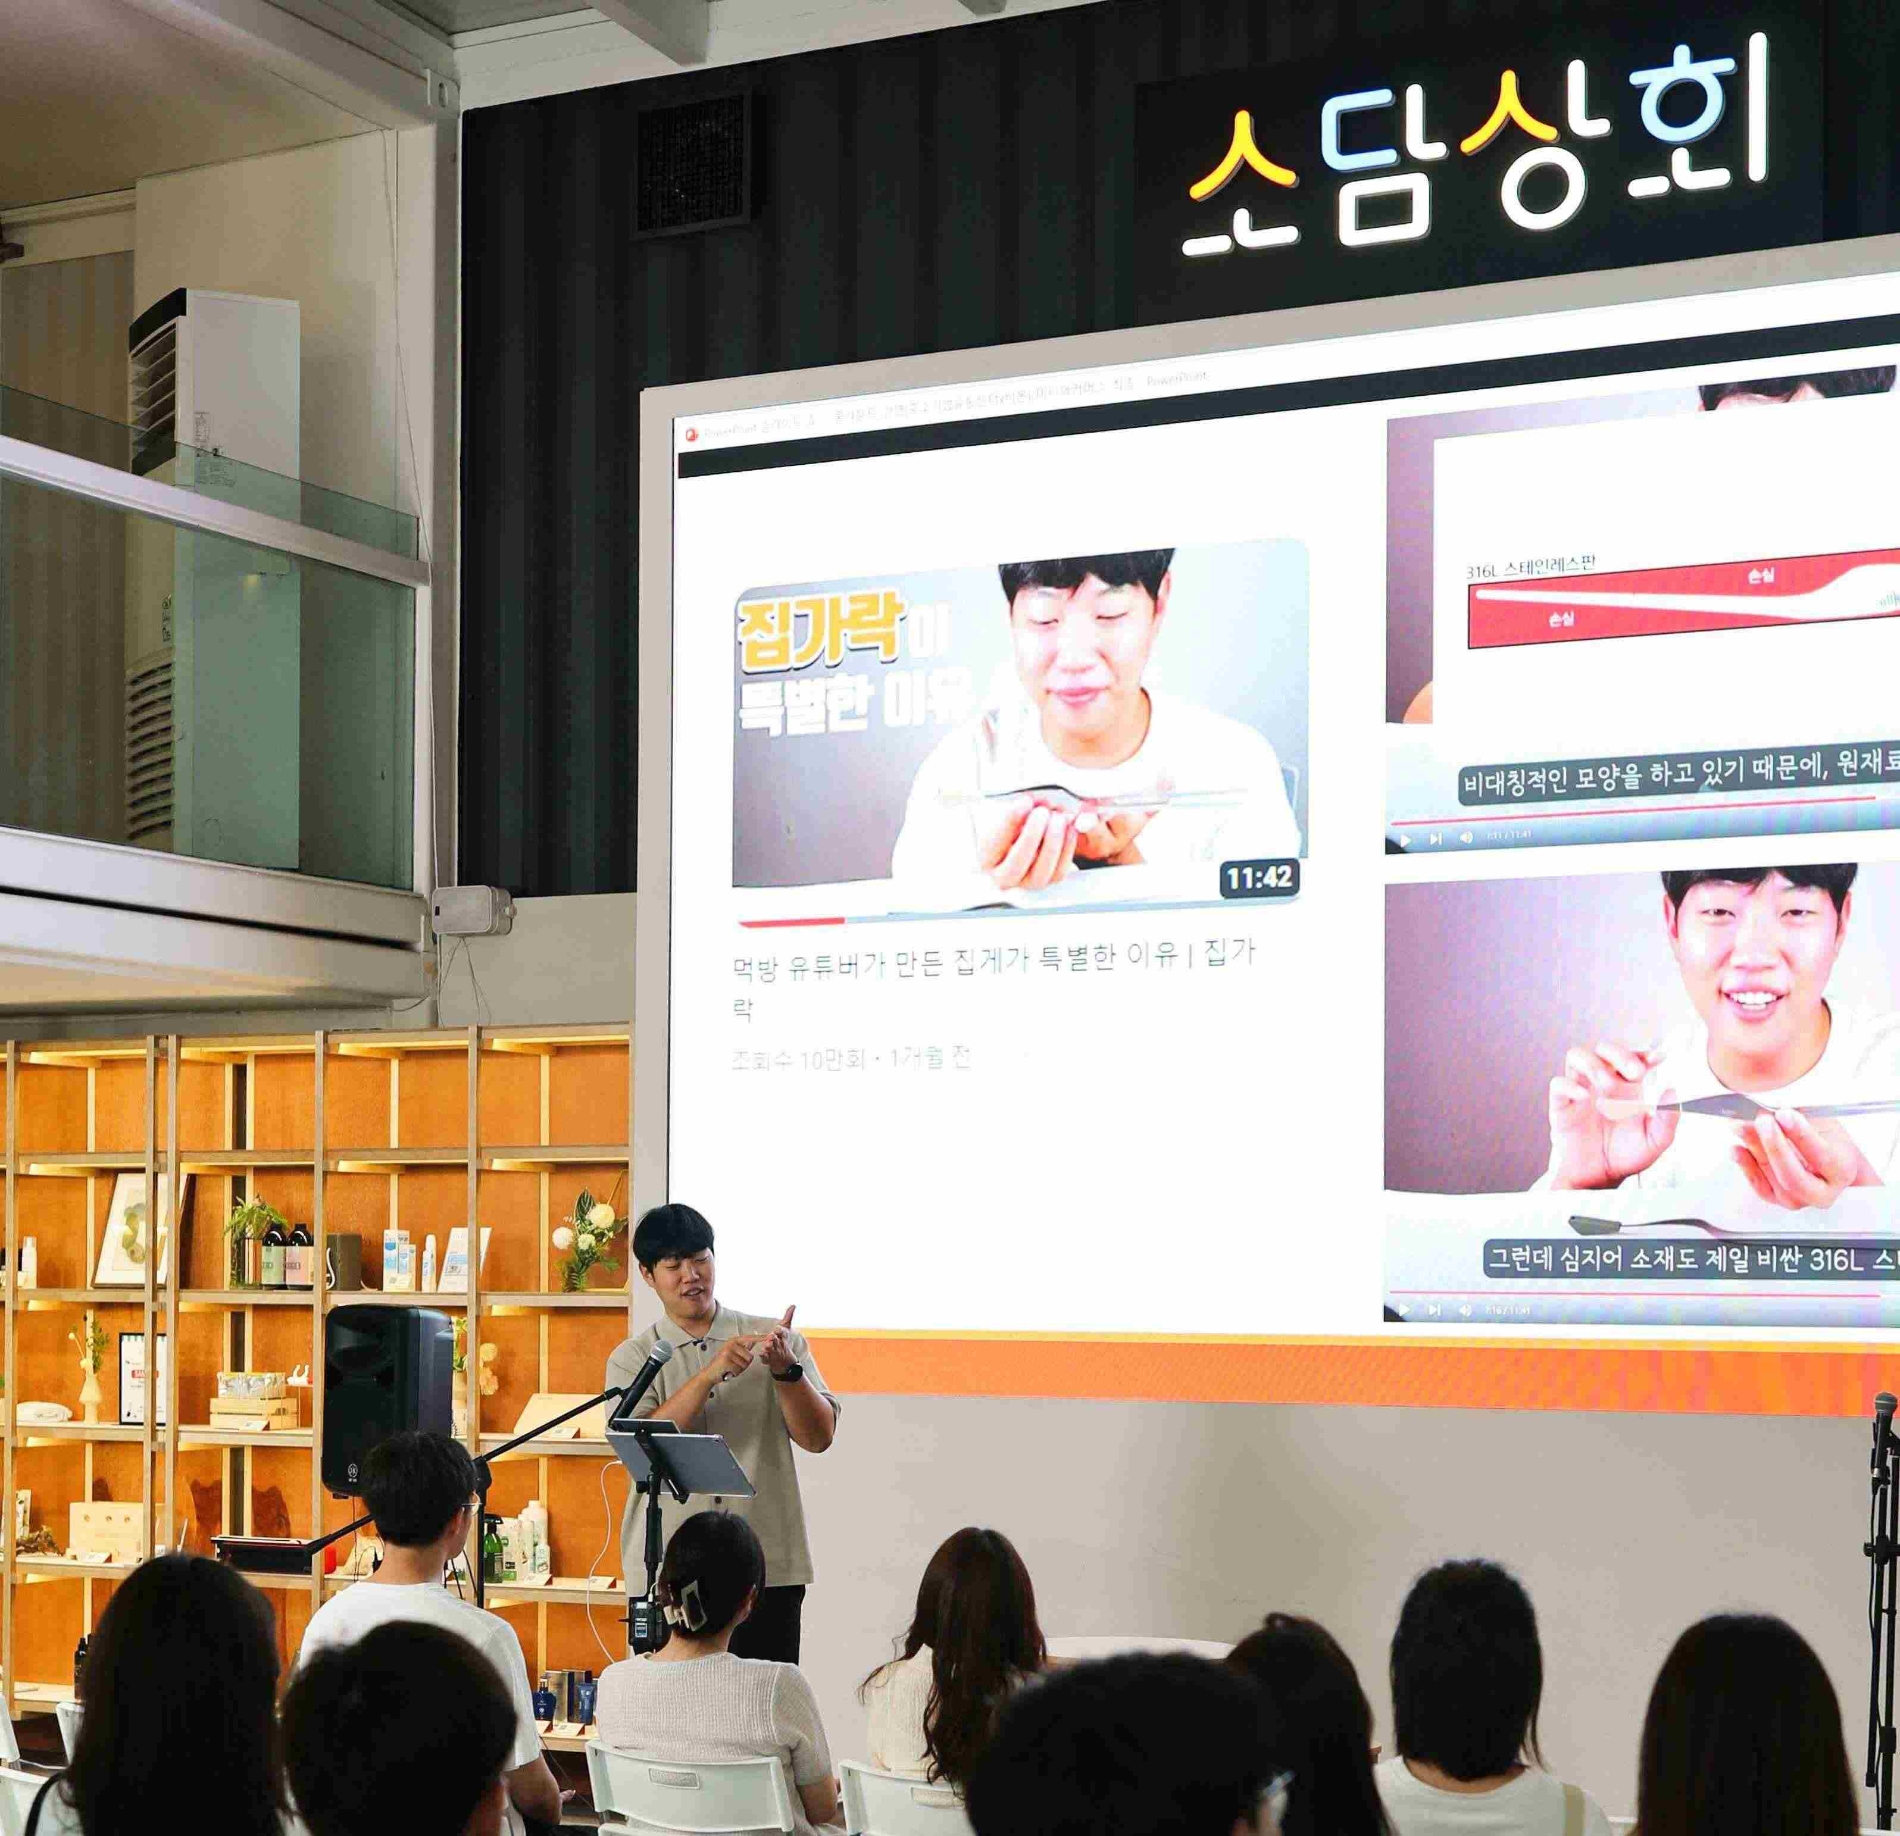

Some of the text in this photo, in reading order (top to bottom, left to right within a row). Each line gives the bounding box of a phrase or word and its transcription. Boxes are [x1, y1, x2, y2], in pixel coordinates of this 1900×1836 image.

[1182, 31, 1769, 258] 소담상회
[1466, 553, 1597, 580] 316L 스테인레스판
[739, 671, 875, 738] 특별한
[1463, 766, 1568, 798] 비대칭적인
[1575, 763, 1643, 793] 모양을
[1650, 760, 1695, 787] 하고
[1703, 756, 1745, 786] 있기
[1752, 751, 1829, 781] 때문에,
[1227, 864, 1293, 890] 11:42
[733, 955, 779, 984] 먹방
[788, 951, 886, 982] 유튜버가
[896, 949, 944, 979] 만든
[953, 947, 1030, 977] 집게가
[1038, 942, 1117, 972] 특별한
[1127, 940, 1179, 969] 이유
[1204, 937, 1257, 967] 집가
[732, 998, 755, 1024] 락
[1489, 1244, 1900, 1274] 그런데 심지어 소재도 제일 비싼 316L 스
